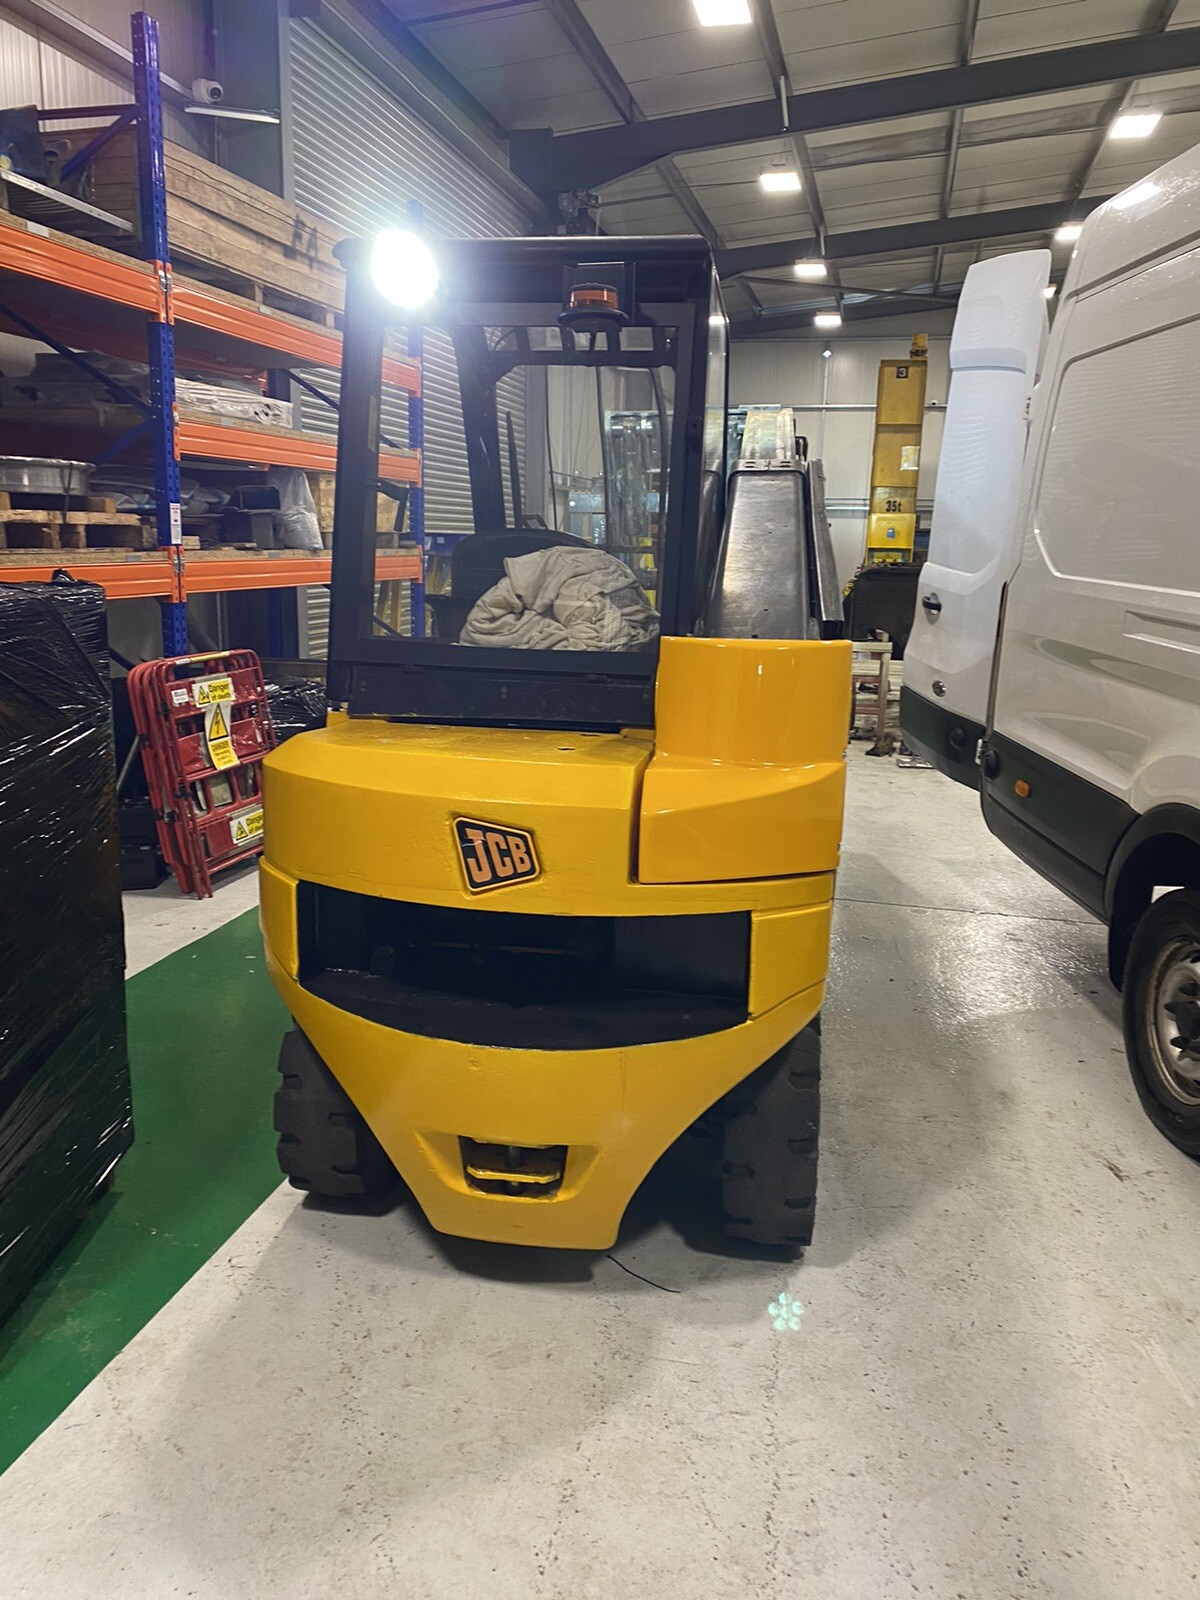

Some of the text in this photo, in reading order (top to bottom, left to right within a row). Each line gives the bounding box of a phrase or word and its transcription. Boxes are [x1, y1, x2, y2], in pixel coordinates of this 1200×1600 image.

[899, 367, 907, 377] 3
[886, 500, 902, 512] 35t
[208, 683, 229, 693] Danger
[465, 827, 531, 883] JCB
